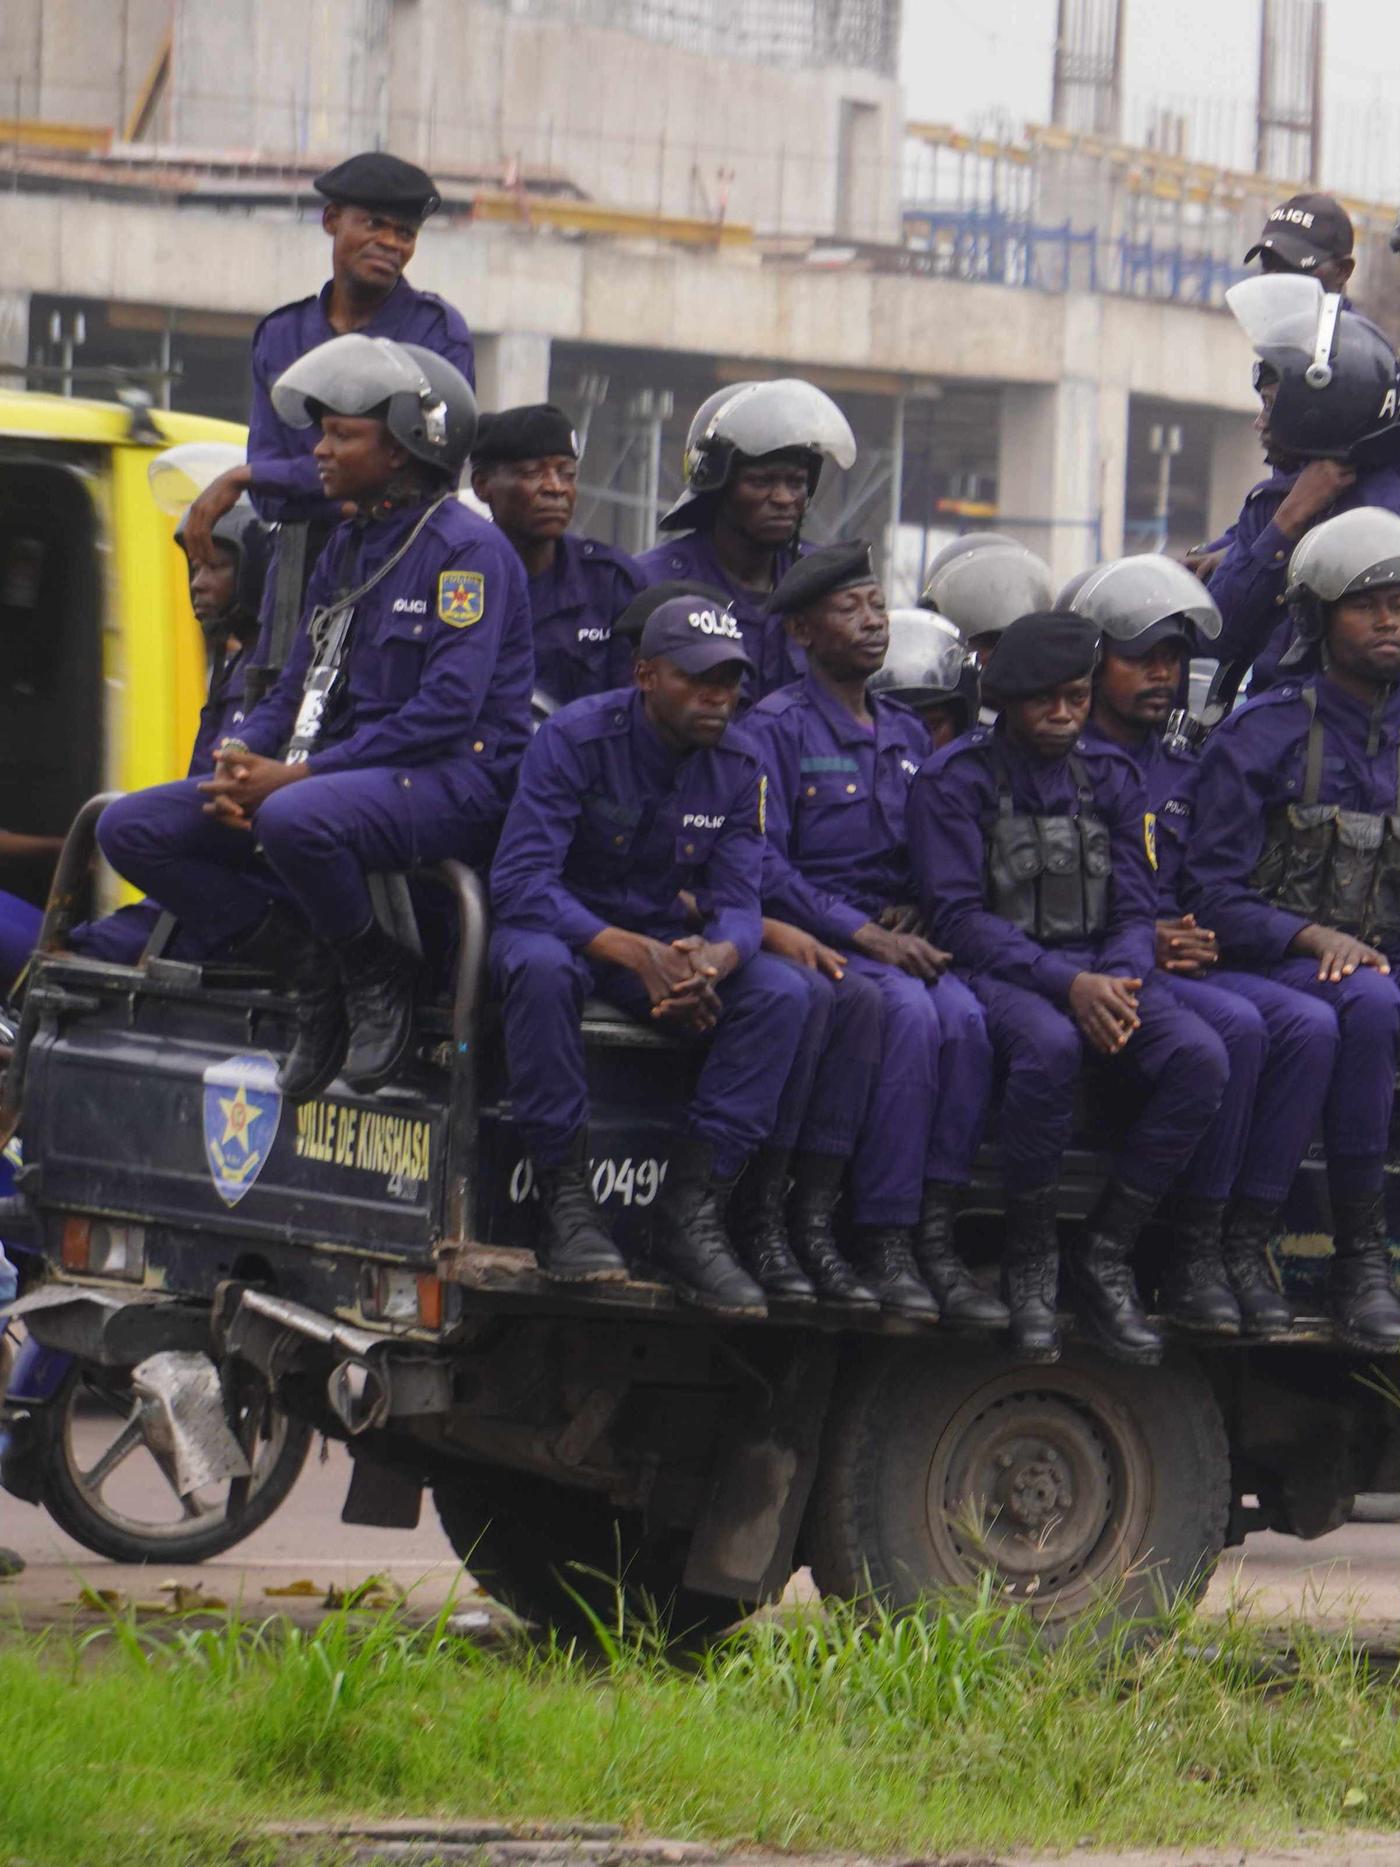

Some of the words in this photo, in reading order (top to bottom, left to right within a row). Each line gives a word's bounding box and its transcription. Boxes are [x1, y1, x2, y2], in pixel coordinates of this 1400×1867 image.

[296, 1101, 337, 1162] VILLE
[334, 1106, 358, 1168] DE
[356, 1111, 431, 1182] KINSHASA
